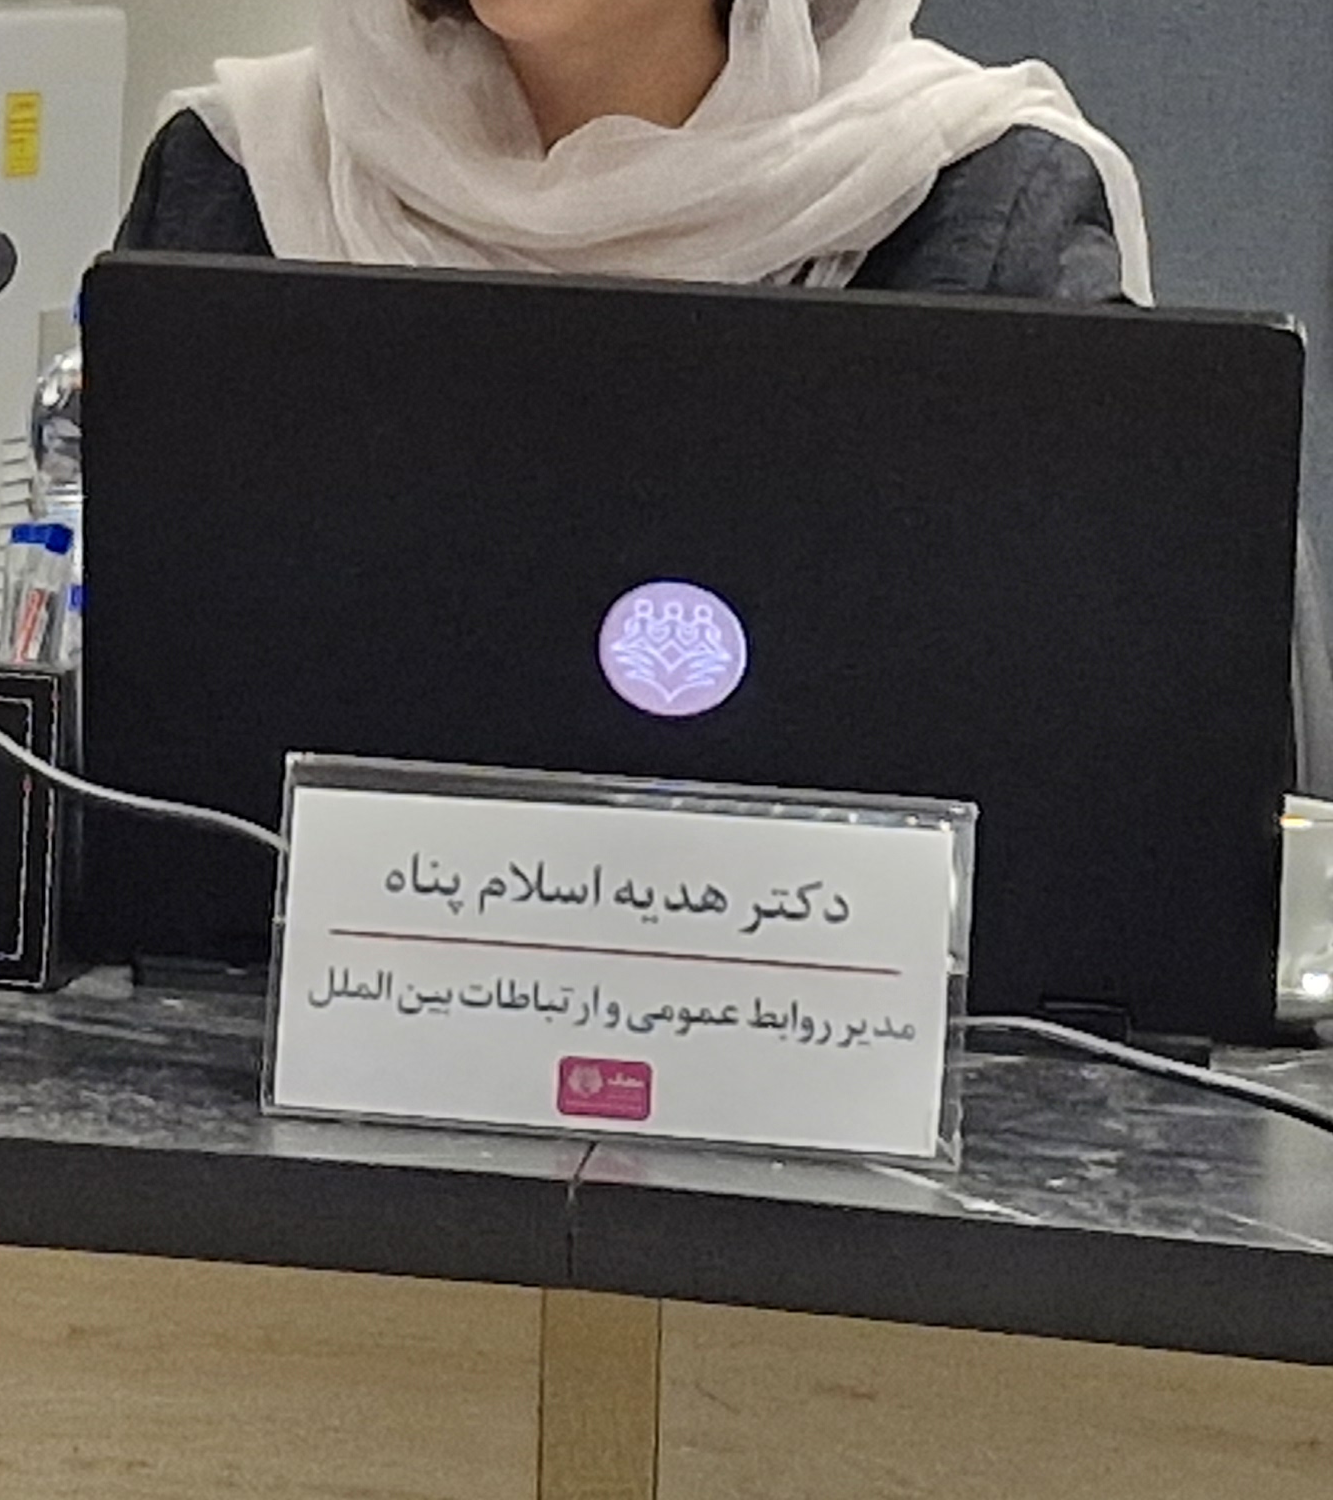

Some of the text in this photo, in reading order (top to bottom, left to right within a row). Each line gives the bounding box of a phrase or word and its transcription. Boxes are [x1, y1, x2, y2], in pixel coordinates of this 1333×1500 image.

[384, 852, 851, 935] دکتر هدیه اسلام پناه
[307, 965, 916, 1049] مدیر روابط عمومی و ارتباطات بین الملل
